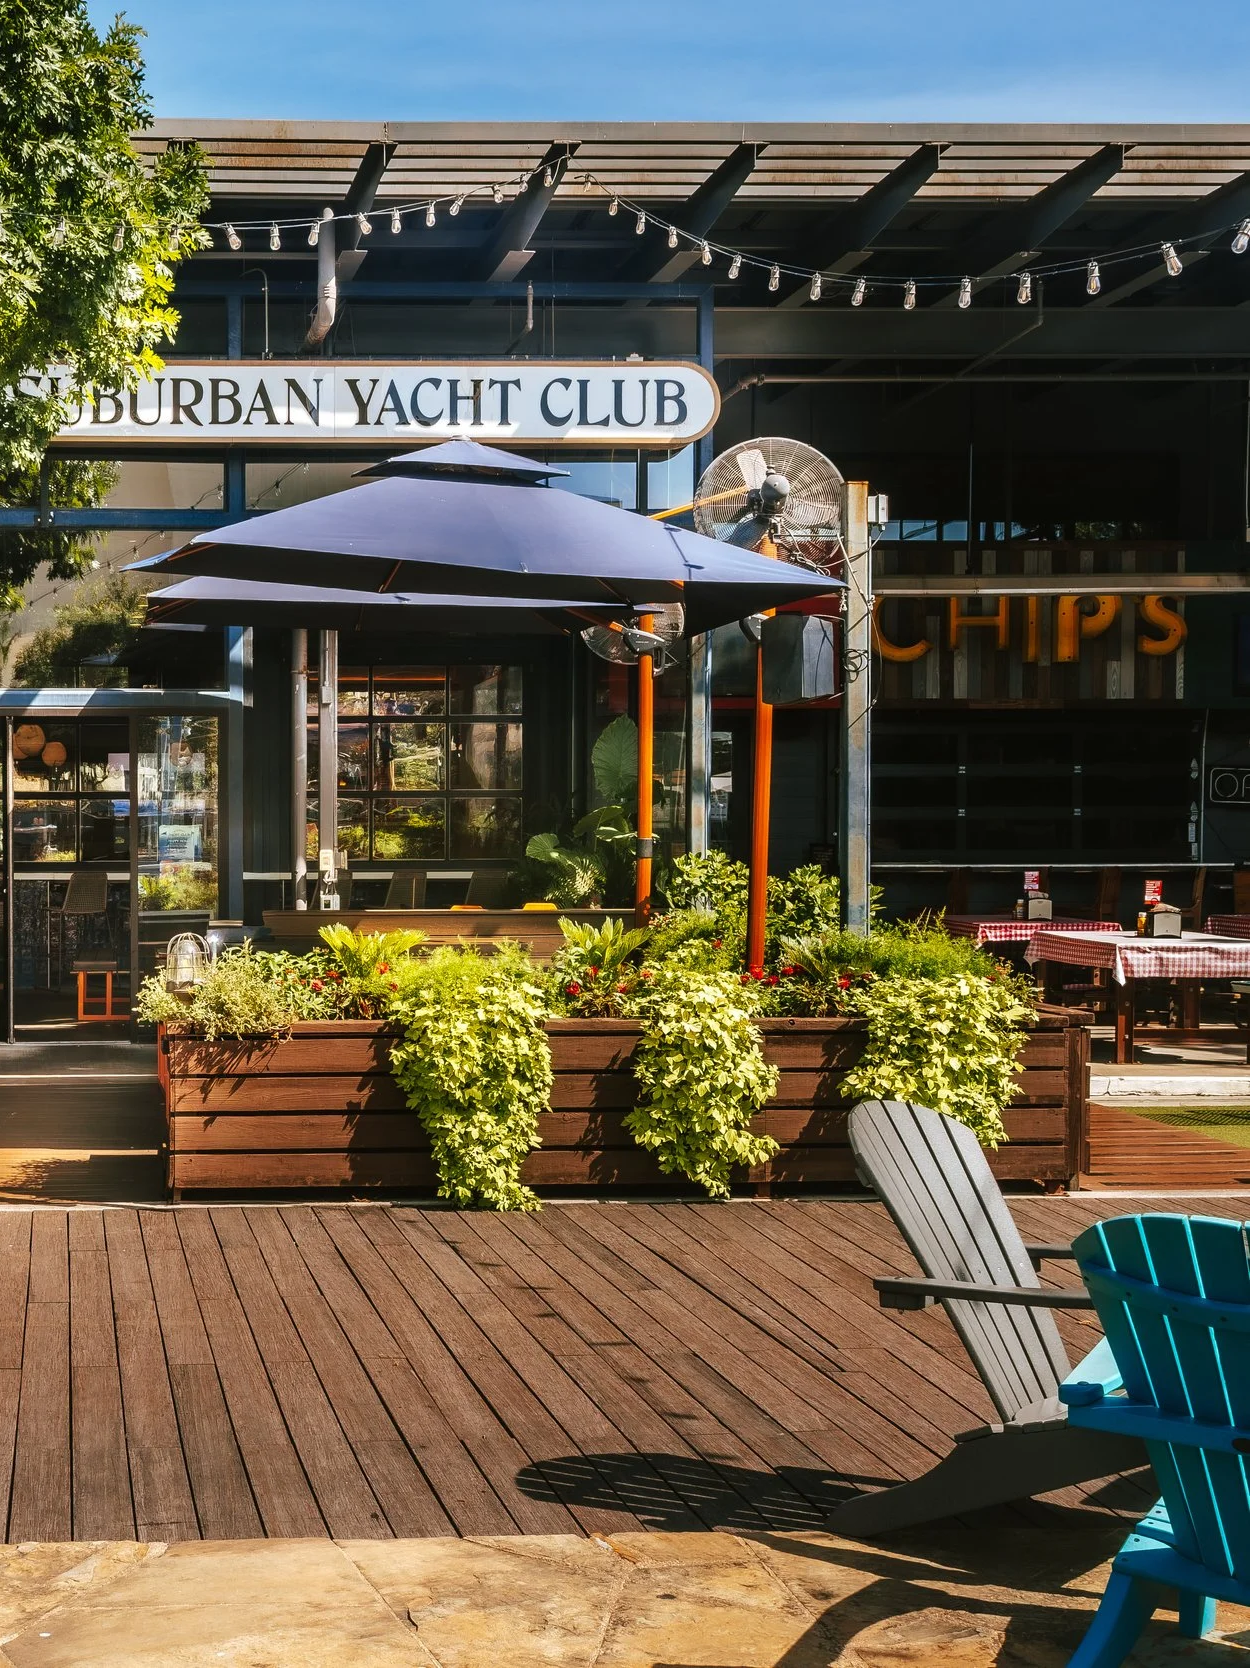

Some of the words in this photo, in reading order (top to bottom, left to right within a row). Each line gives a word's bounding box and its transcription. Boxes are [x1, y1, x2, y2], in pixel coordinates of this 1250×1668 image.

[344, 377, 522, 427] YACHT
[540, 377, 688, 427] CLUB
[871, 595, 1187, 662] CHIPS
